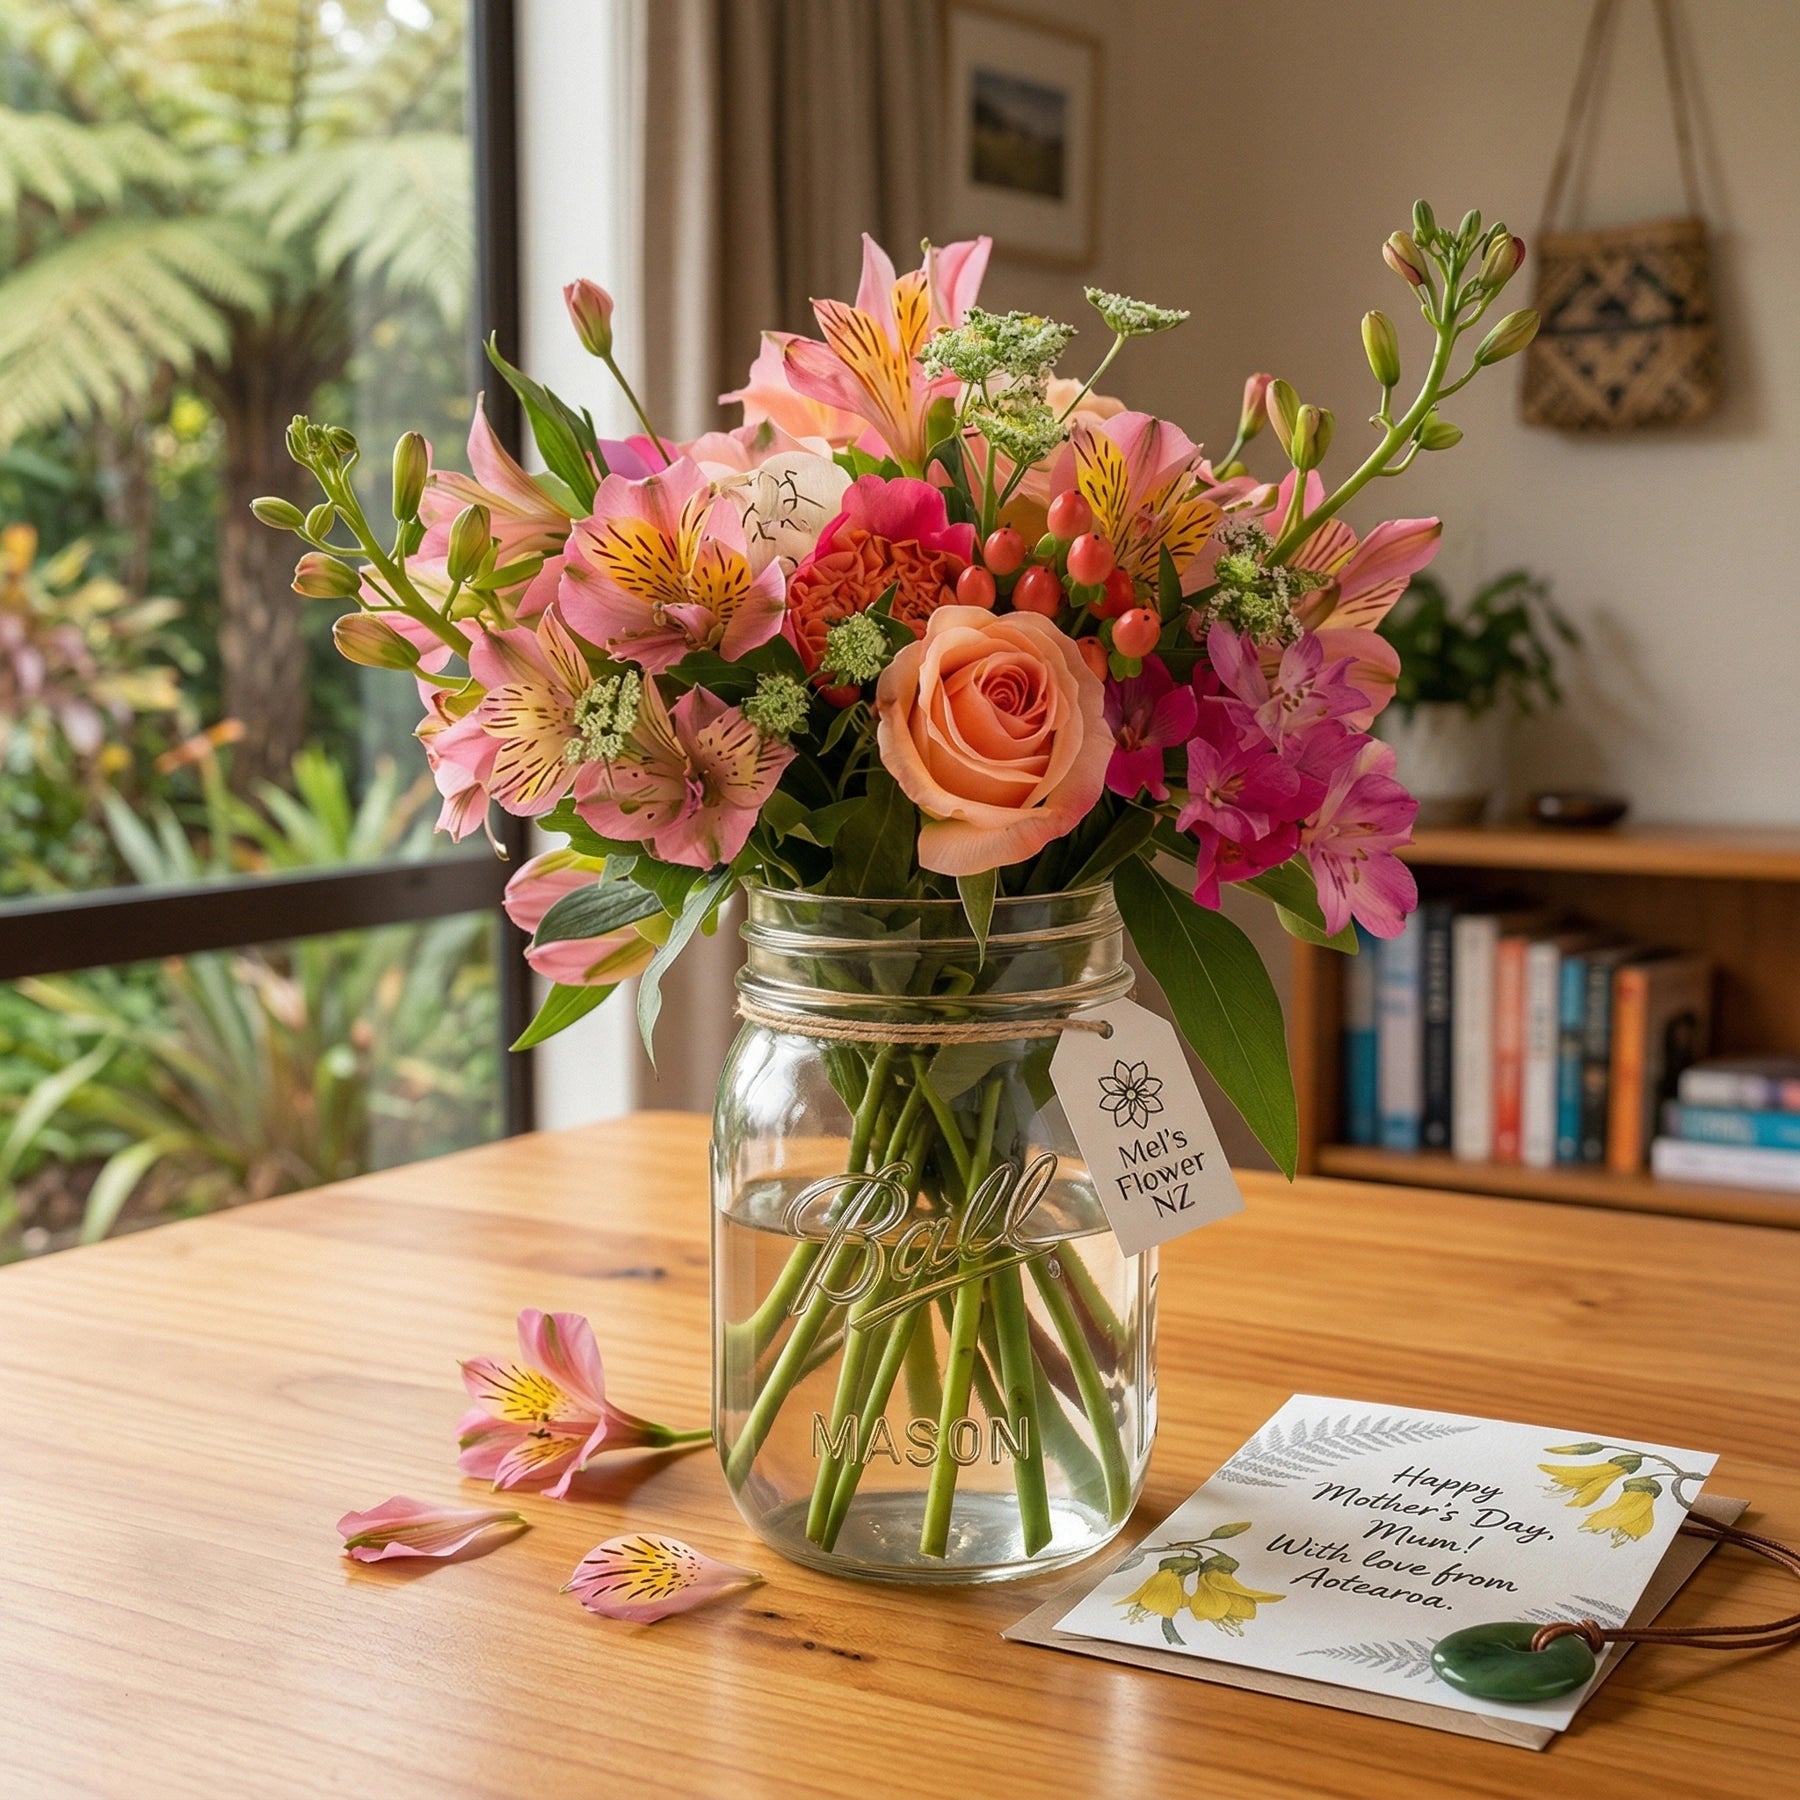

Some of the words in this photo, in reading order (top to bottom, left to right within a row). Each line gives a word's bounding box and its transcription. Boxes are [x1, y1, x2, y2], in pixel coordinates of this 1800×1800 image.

[1118, 1128, 1188, 1169] Mel's
[1115, 1152, 1204, 1201] Flower
[1151, 1183, 1195, 1218] NZ
[782, 1152, 1060, 1318] Ball
[811, 1411, 1029, 1468] MASON
[1392, 1466, 1503, 1504] Happy
[1312, 1481, 1459, 1523] Mother's
[1469, 1508, 1555, 1545] Day,
[1362, 1519, 1484, 1554] Mum!
[1266, 1533, 1352, 1564] With
[1362, 1549, 1431, 1576] love
[1431, 1562, 1518, 1594] from
[1289, 1567, 1453, 1611] Aotearoa.
